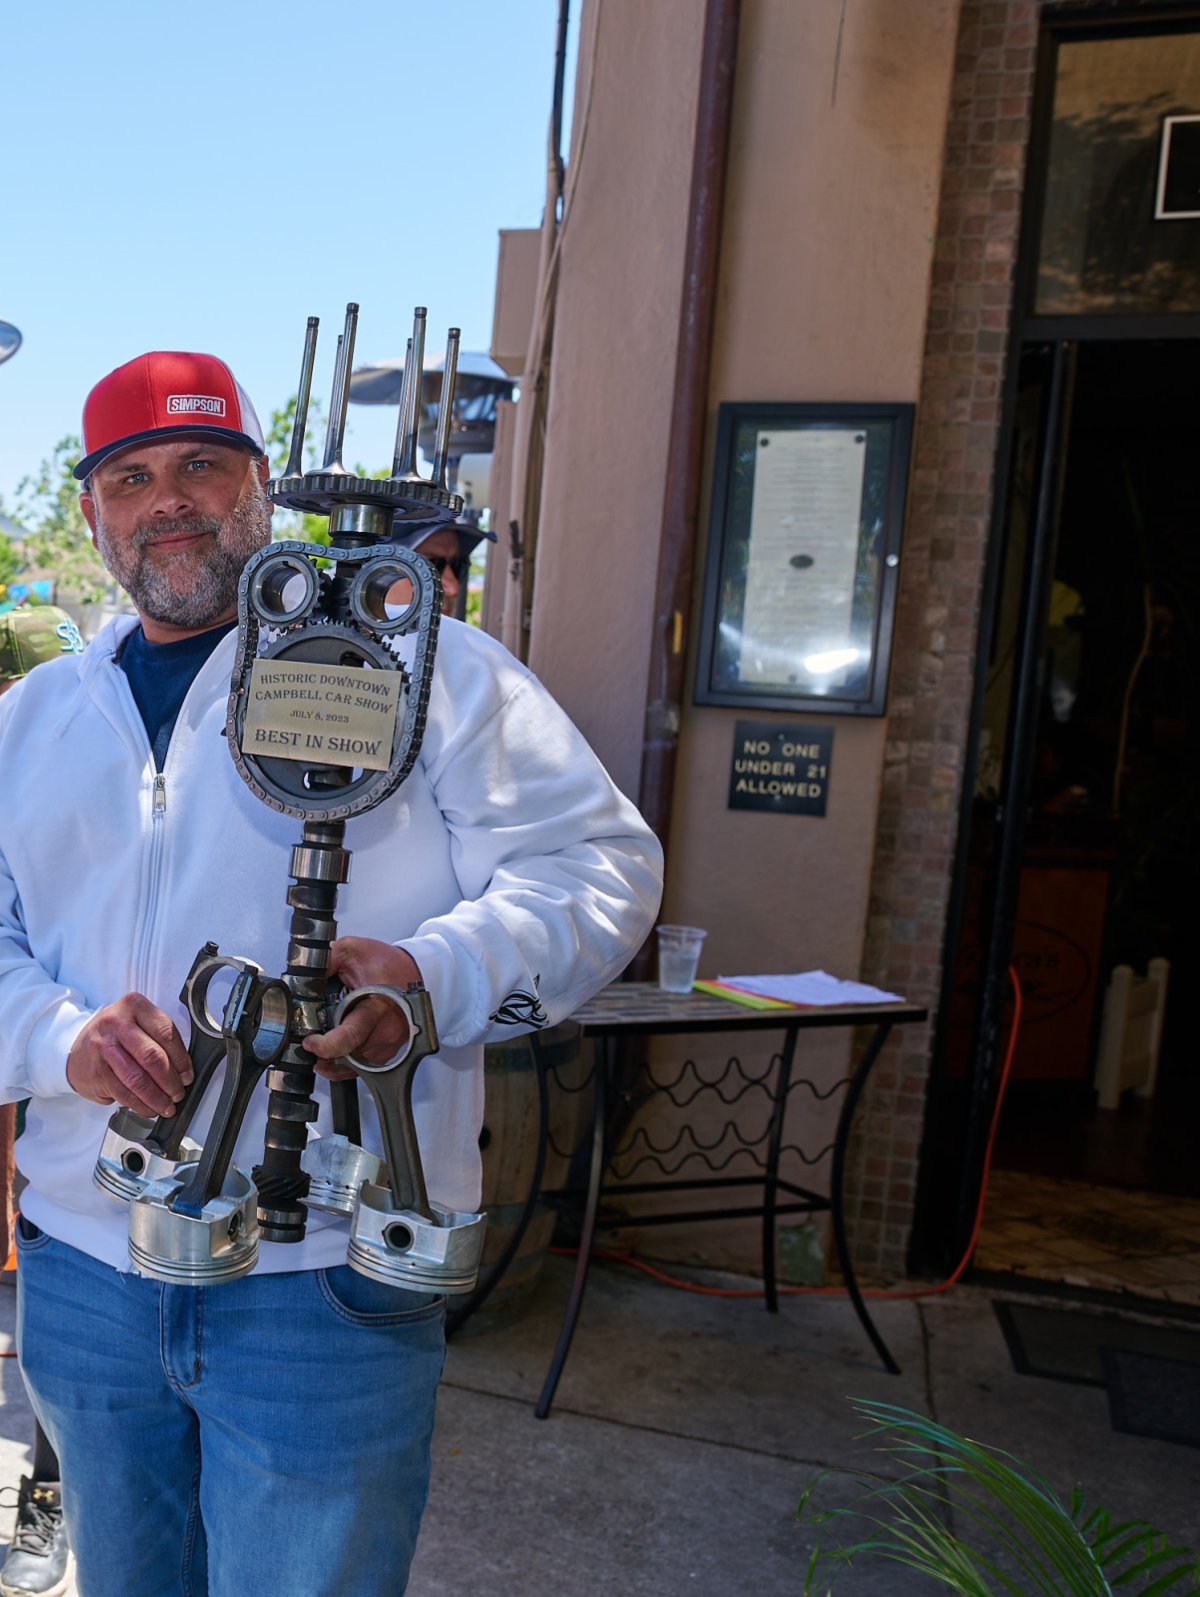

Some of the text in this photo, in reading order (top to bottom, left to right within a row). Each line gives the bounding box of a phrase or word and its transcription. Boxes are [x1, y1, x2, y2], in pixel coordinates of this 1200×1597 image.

[171, 398, 221, 413] SIMPSON
[260, 673, 391, 697] HISTORIC DOWNTOWN
[255, 690, 393, 714] CAMPBELL CAR SHOW
[290, 710, 314, 719] JULY
[326, 713, 349, 723] 2023
[255, 728, 383, 756] BEST IN SHOW
[743, 740, 820, 759] NO ONE
[734, 759, 827, 779] UNDER 21
[735, 778, 822, 798] ALLOWED
